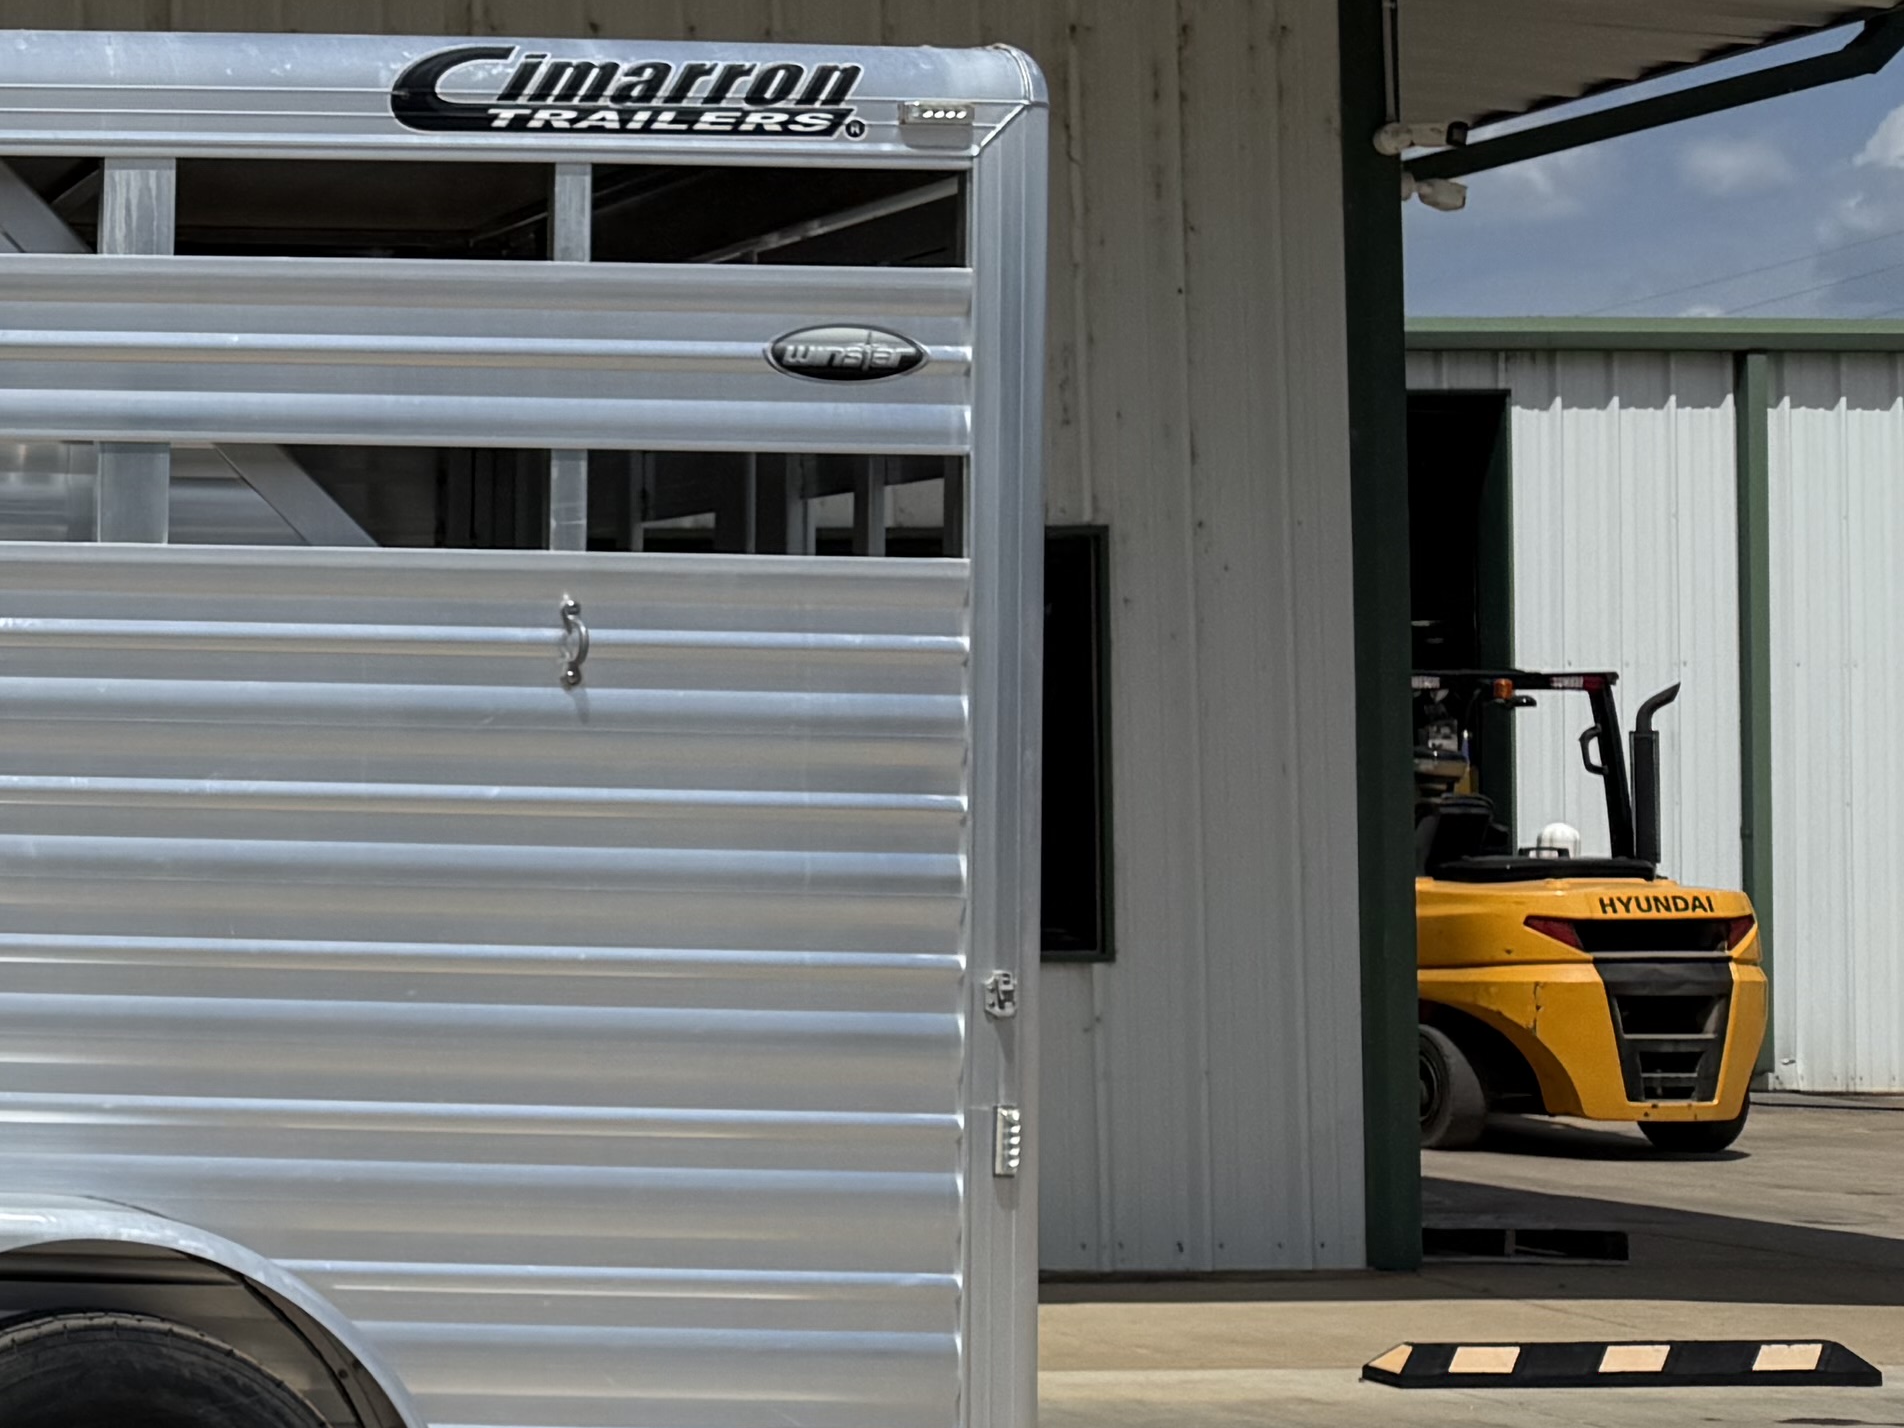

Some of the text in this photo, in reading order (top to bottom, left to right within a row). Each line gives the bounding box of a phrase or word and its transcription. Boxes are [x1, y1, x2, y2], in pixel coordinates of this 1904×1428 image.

[390, 45, 865, 134] Cimarron
[487, 108, 837, 133] TRAILERS
[1598, 894, 1715, 914] HYUNDAI
